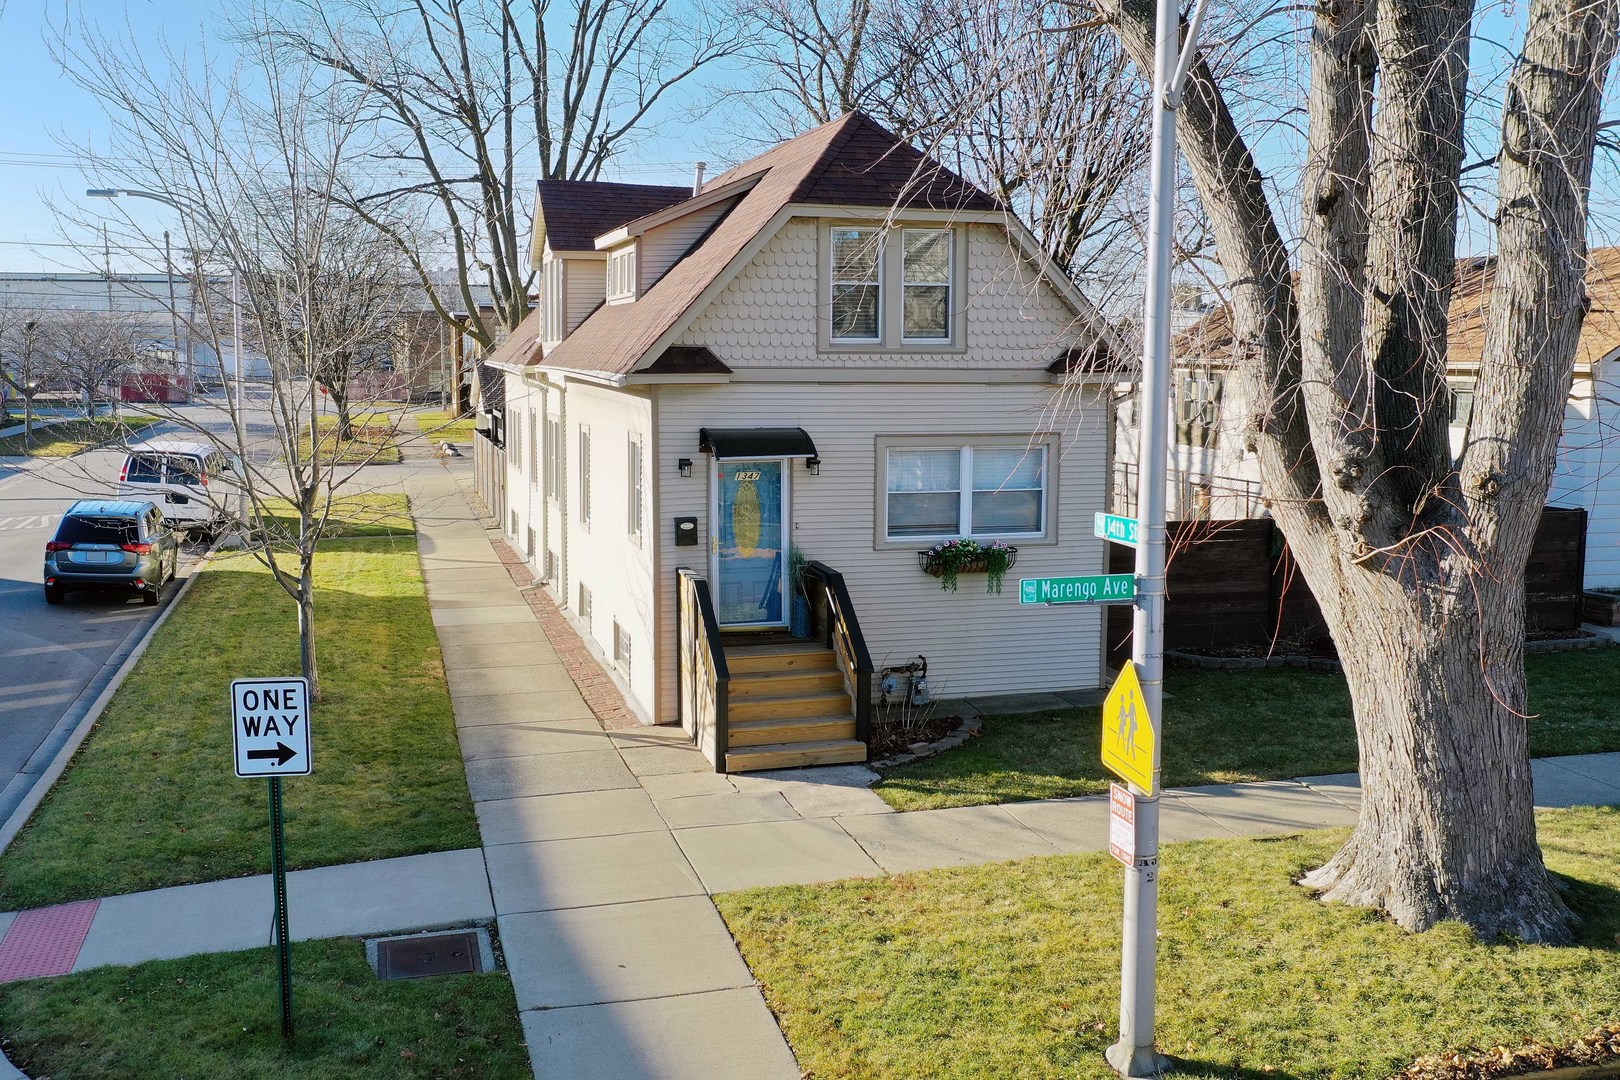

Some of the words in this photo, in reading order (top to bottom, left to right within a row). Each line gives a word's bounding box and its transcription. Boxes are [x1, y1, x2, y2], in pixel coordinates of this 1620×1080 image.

[736, 472, 760, 480] 1347
[1107, 518, 1125, 539] 14th
[1042, 580, 1097, 600] Marengo
[1103, 577, 1128, 595] Ave
[243, 689, 298, 711] ONE
[242, 715, 299, 737] WAY
[1113, 788, 1132, 808] SNOW
[1112, 800, 1133, 823] ROUTE
